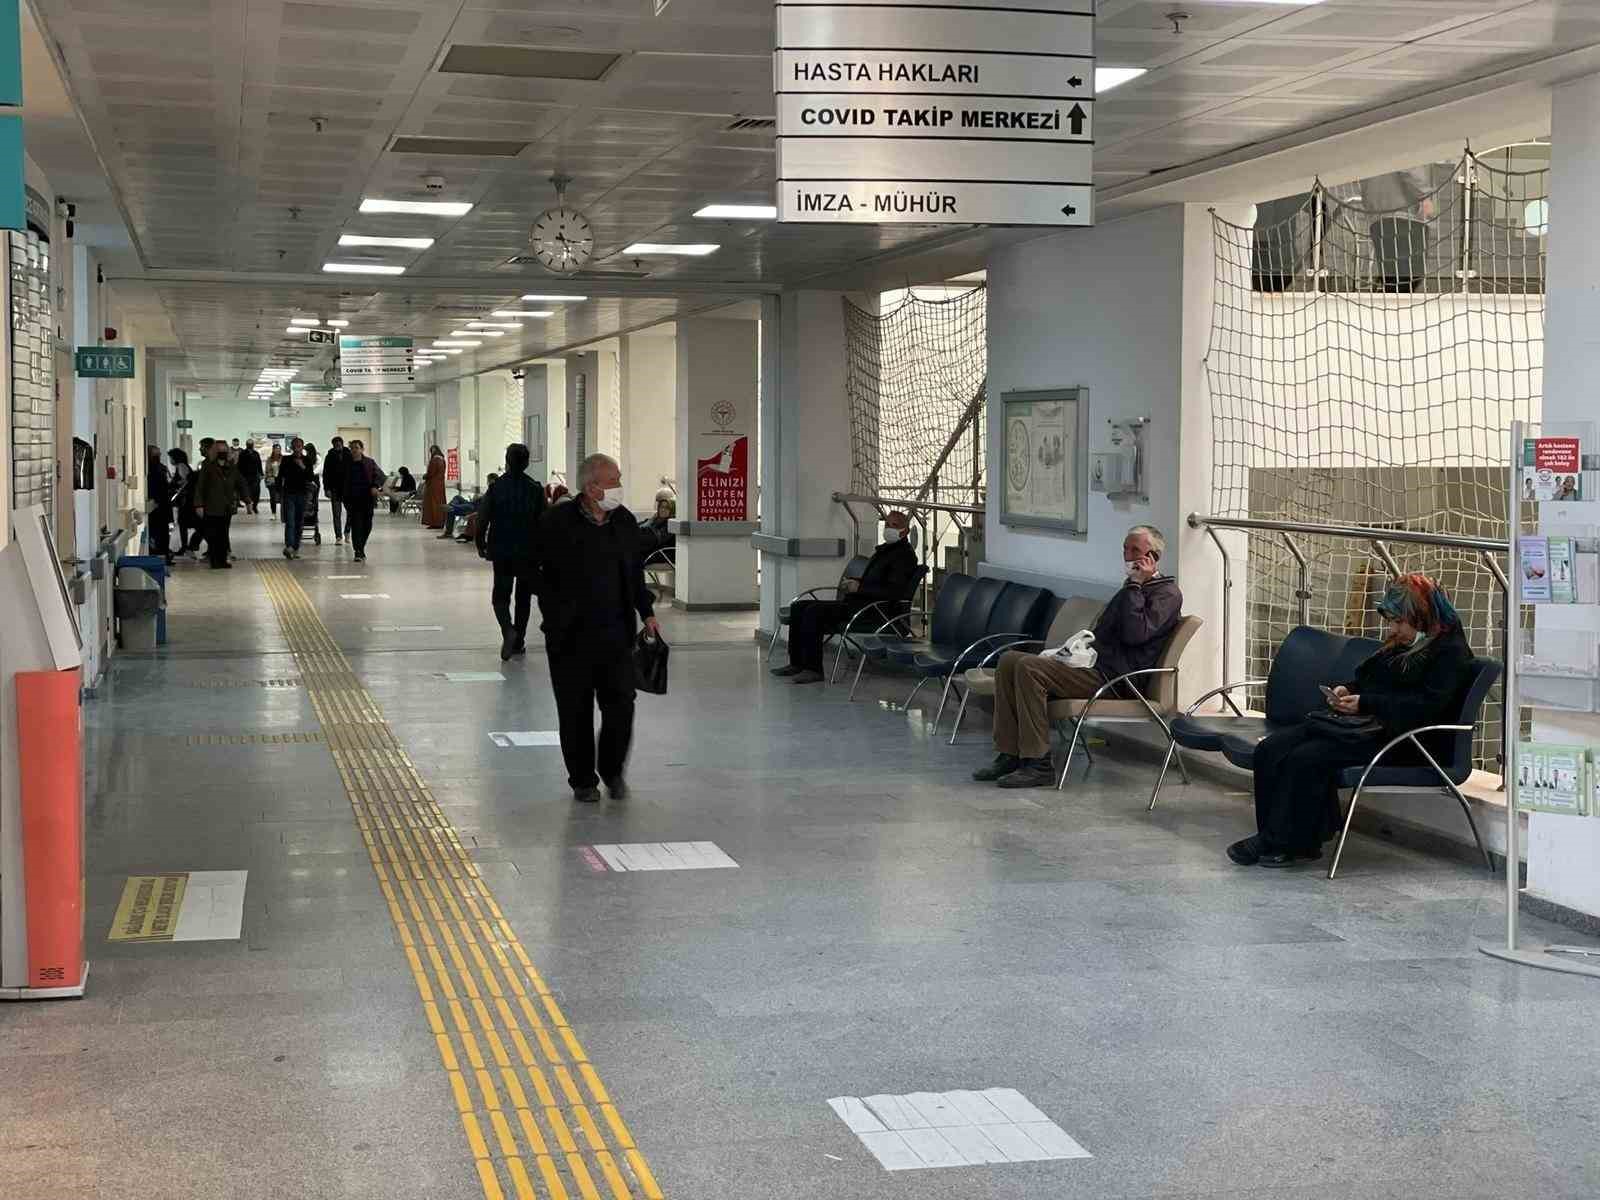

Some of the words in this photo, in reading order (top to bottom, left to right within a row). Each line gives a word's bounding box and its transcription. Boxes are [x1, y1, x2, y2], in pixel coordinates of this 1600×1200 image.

[794, 63, 871, 81] HASTA
[879, 63, 979, 83] HAKLARI
[801, 108, 875, 126] COVID
[884, 106, 954, 128] TAKİP
[961, 109, 1060, 130] MERKEZİ
[797, 189, 853, 212] İMZA
[874, 190, 957, 214] MÜHÜR
[702, 489, 744, 498] LÜTFEN
